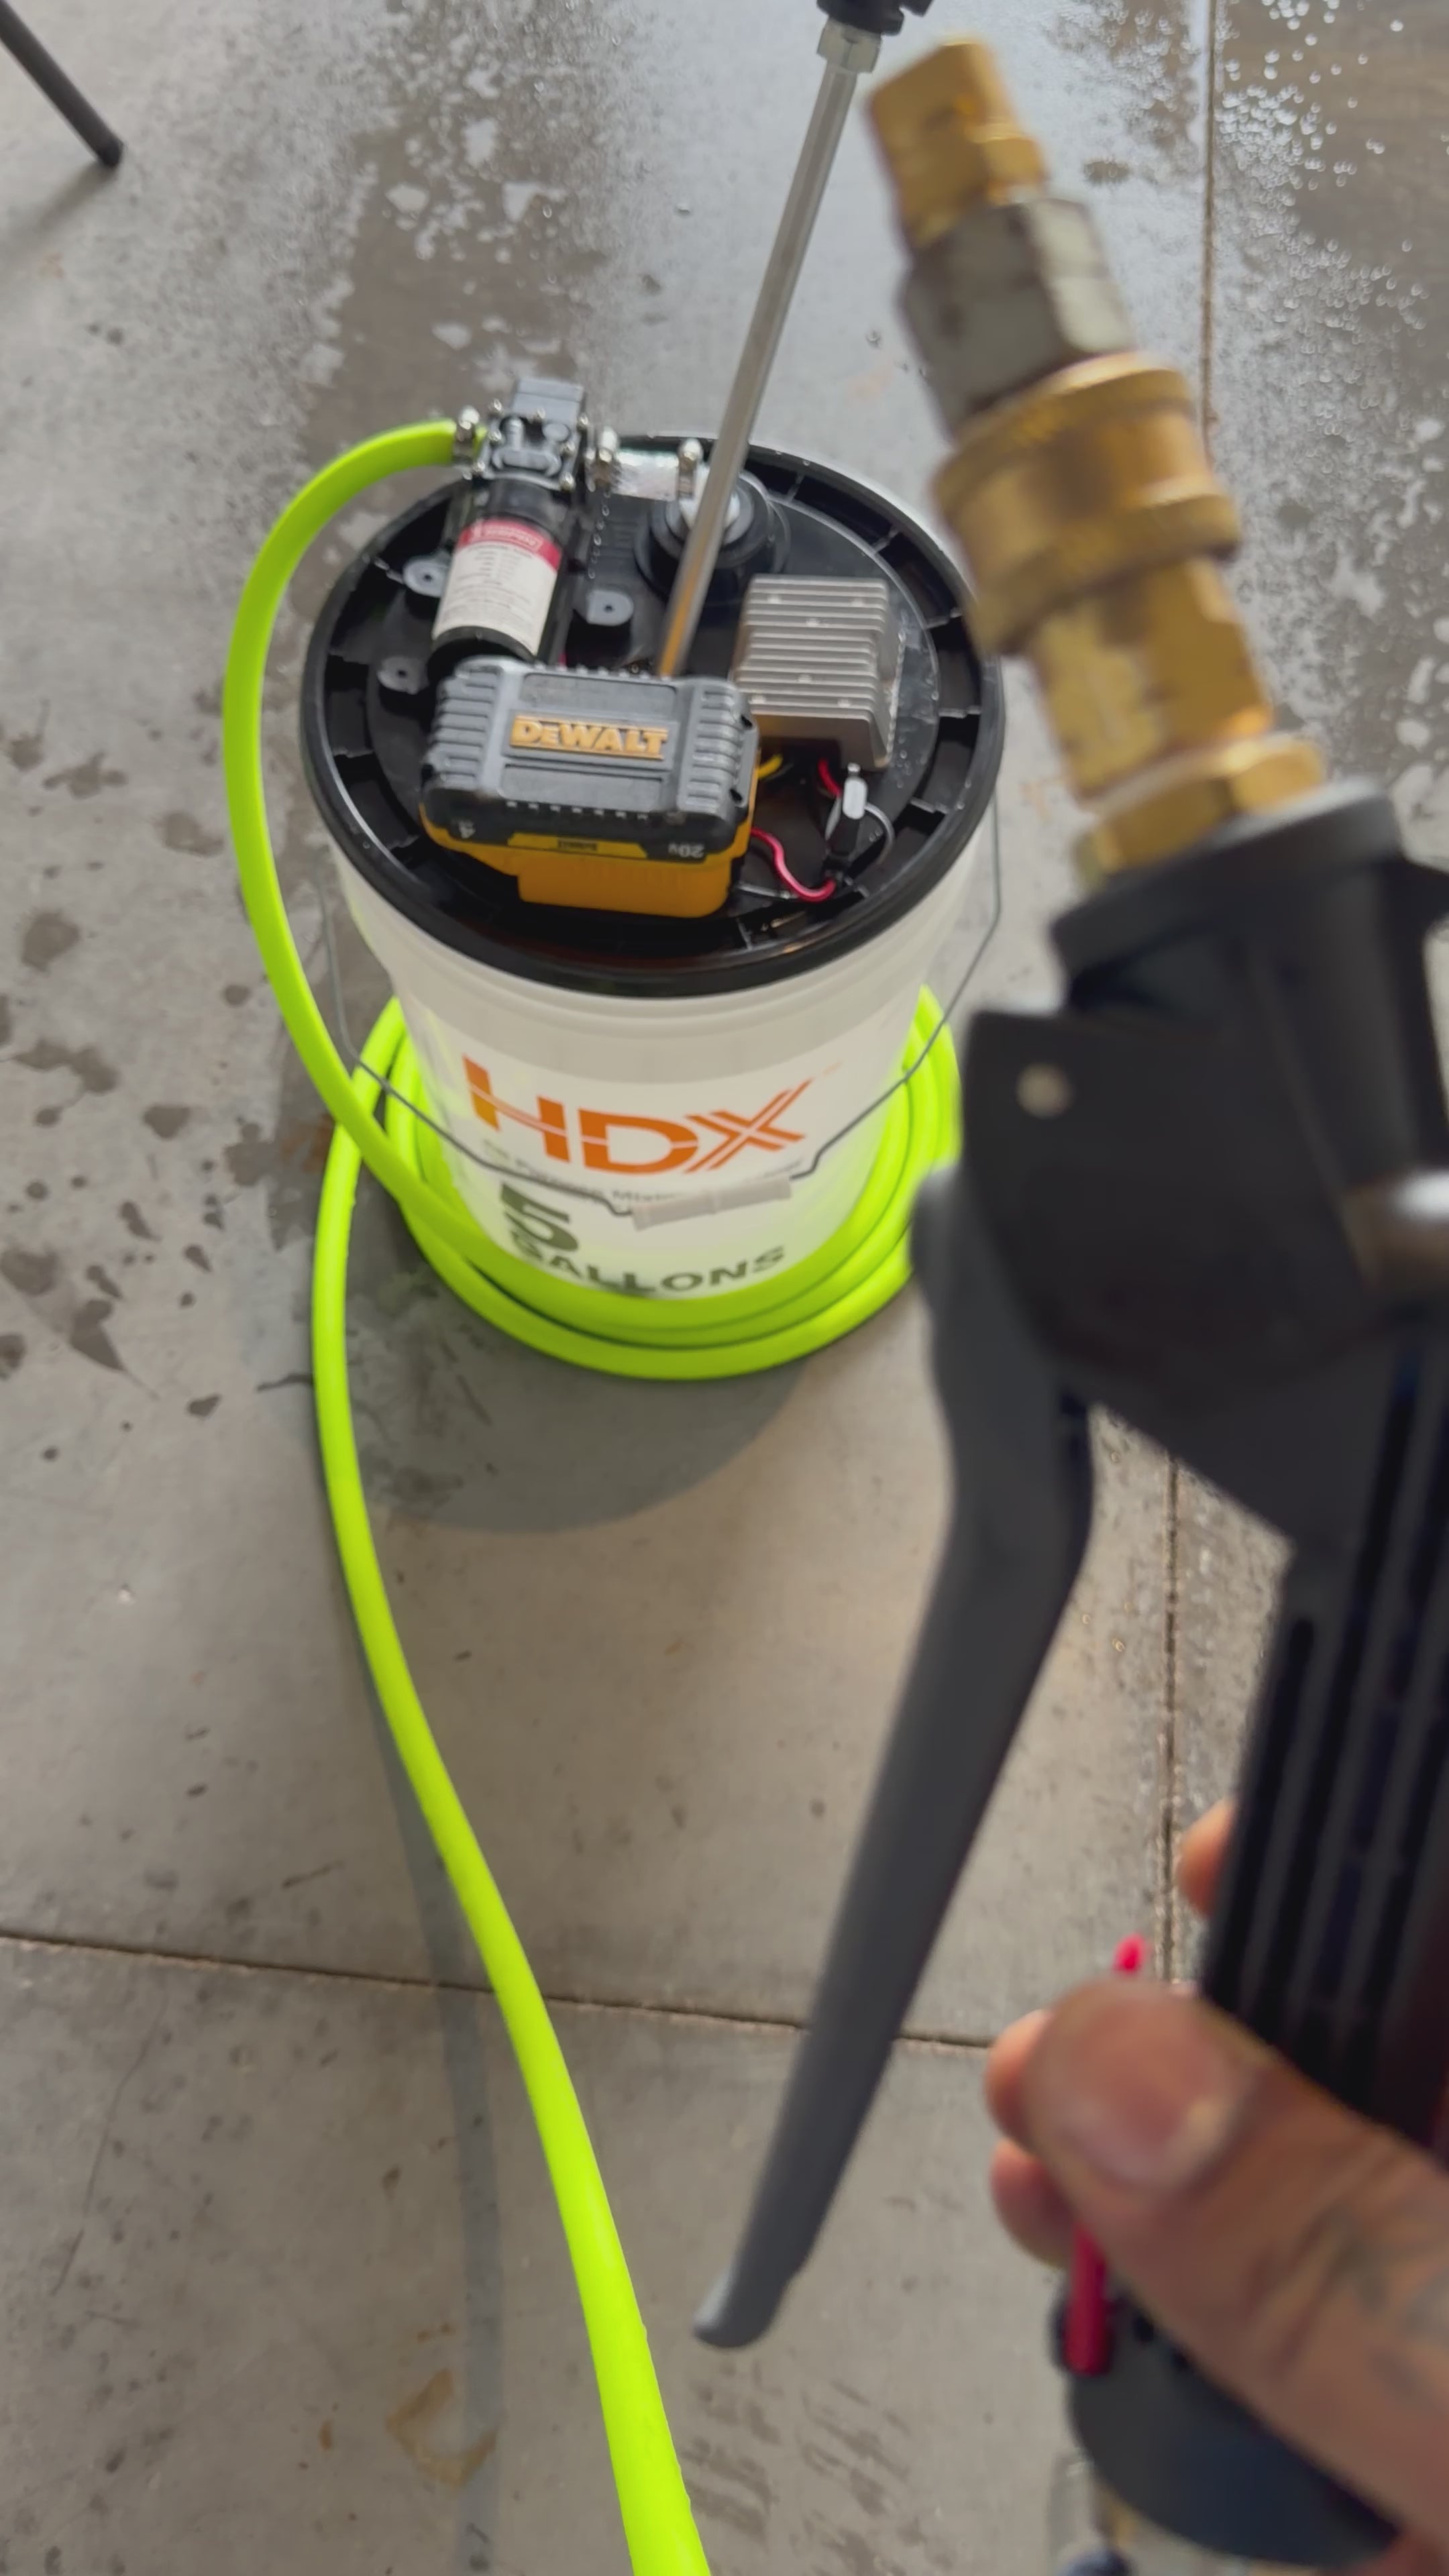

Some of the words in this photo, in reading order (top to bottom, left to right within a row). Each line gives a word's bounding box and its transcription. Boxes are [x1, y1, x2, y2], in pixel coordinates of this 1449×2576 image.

[462, 1055, 813, 1175] HDX
[500, 1183, 580, 1252] 5
[512, 1229, 785, 1293] GALLONS
